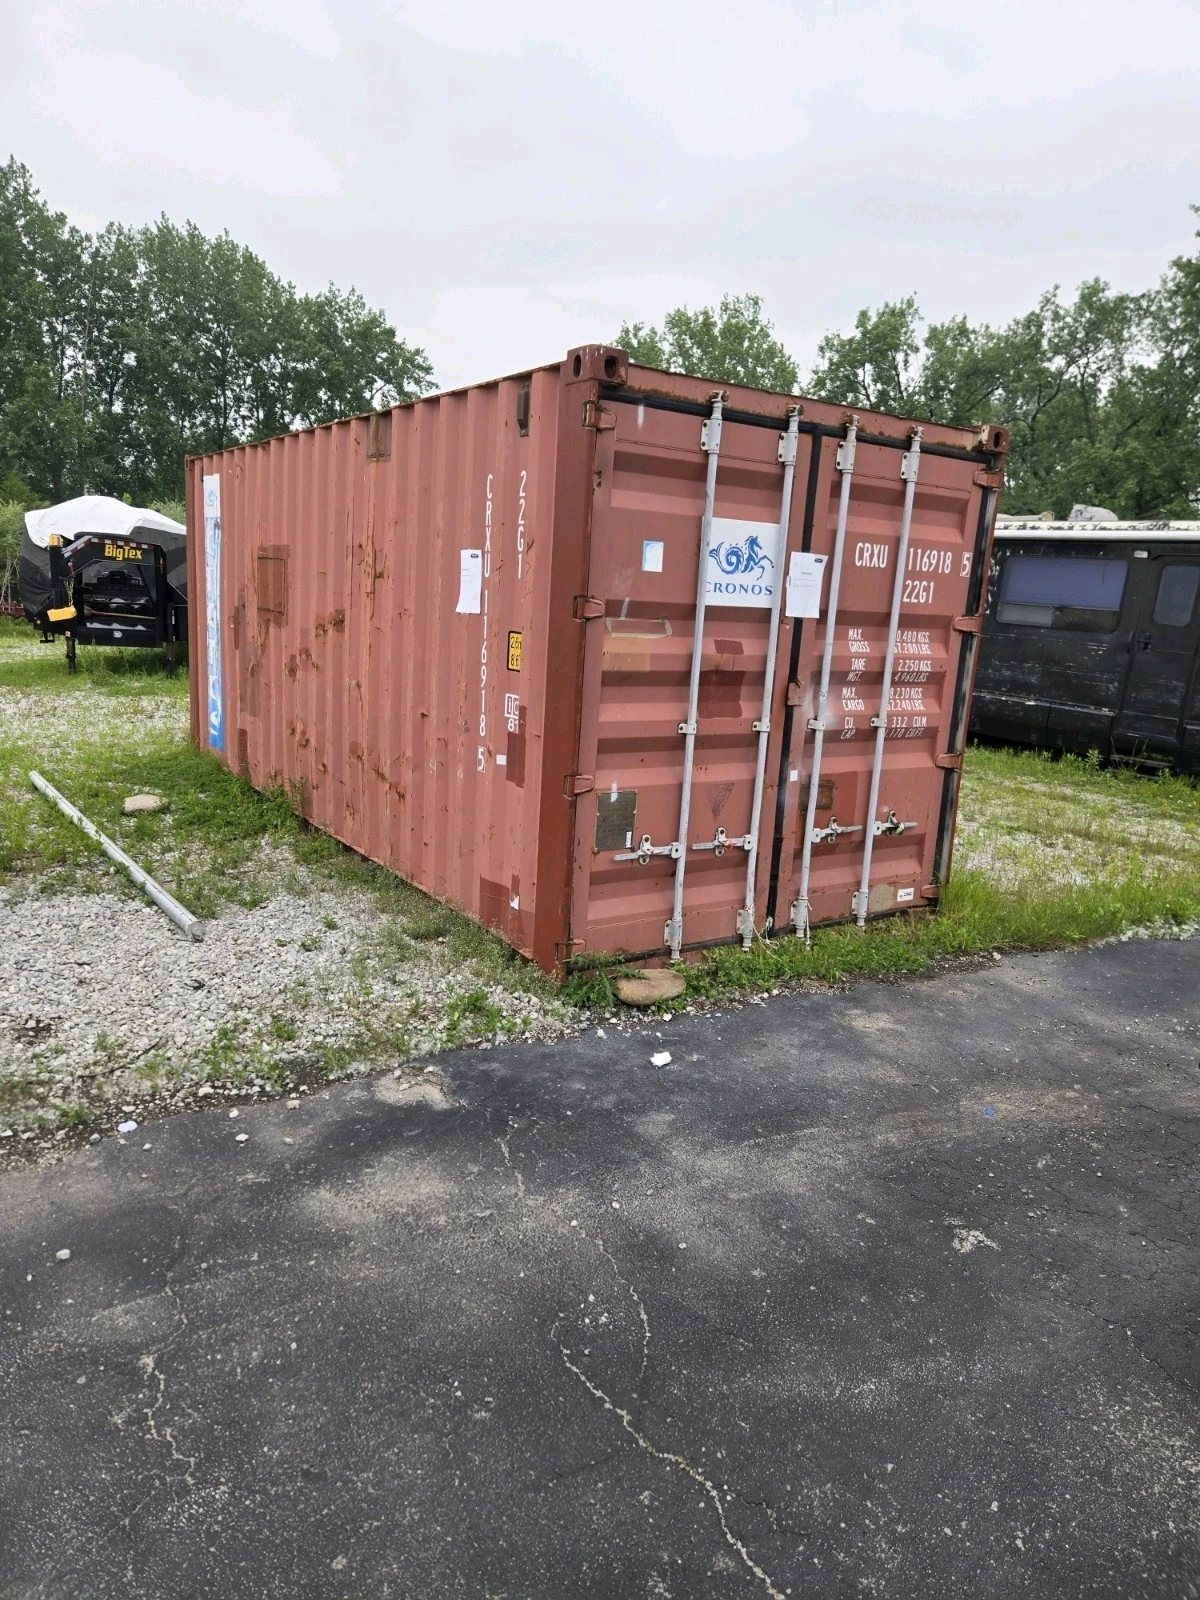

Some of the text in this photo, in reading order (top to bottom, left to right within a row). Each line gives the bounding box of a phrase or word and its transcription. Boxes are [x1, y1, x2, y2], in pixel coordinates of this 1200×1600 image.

[517, 470, 527, 579] 22G1
[854, 542, 970, 576] CRXU 116918 5
[902, 580, 934, 604] 22G1
[478, 473, 494, 771] CRXU 116918 5
[848, 628, 864, 640] MAX.
[848, 641, 870, 653] GROSS
[852, 658, 866, 670] TARE
[842, 687, 858, 699] MAX.
[842, 699, 865, 711] CARGO
